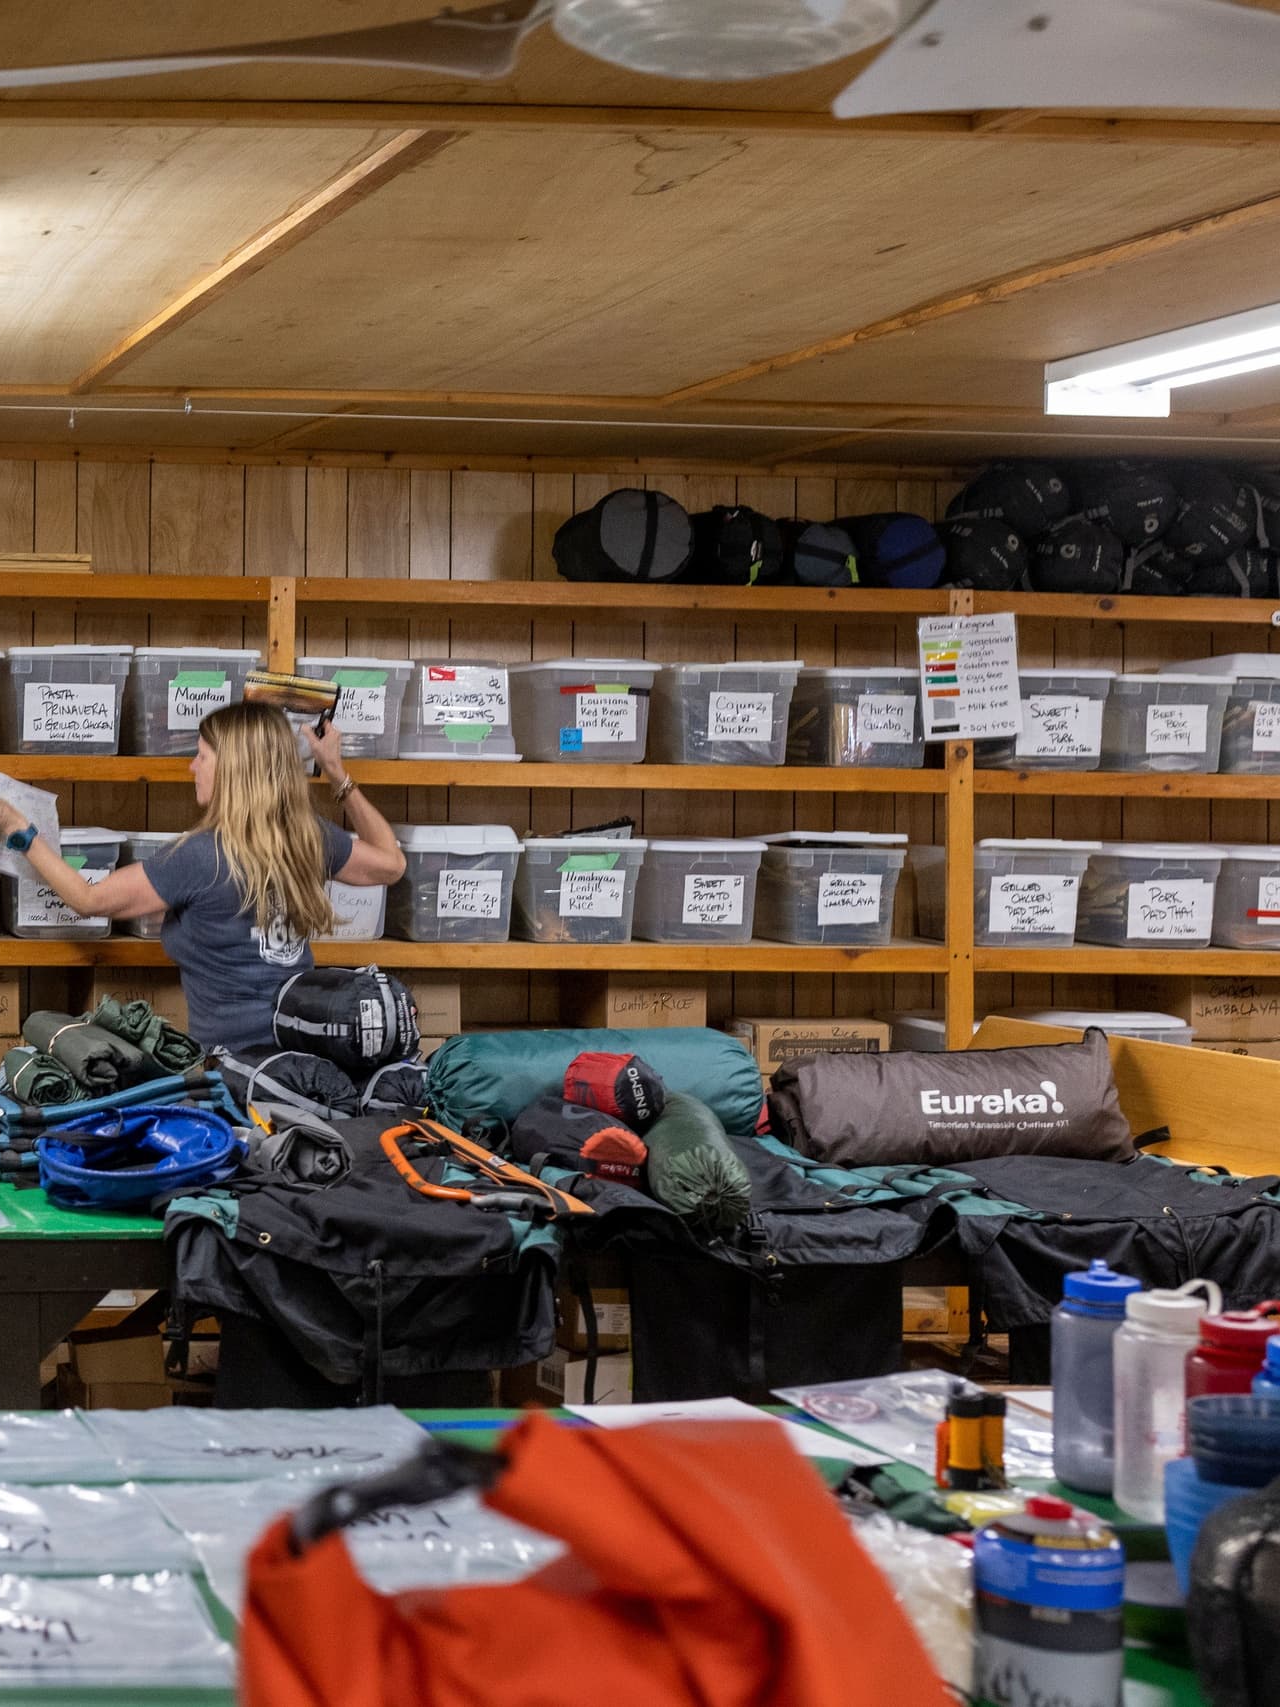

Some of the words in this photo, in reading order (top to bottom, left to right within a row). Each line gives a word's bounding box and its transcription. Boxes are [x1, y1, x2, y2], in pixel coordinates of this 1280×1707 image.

[928, 621, 954, 632] Food
[959, 619, 996, 633] Legend
[175, 688, 225, 703] Mountain
[968, 687, 987, 695] Nut
[580, 695, 629, 706] Louisiana
[715, 695, 755, 714] Cajun
[968, 702, 987, 711] Milk
[176, 703, 203, 718] Chili
[580, 707, 597, 717] Red
[602, 706, 629, 716] Beans
[860, 703, 904, 717] Chicken
[1030, 703, 1073, 718] SWEET
[600, 718, 620, 728] Rice
[715, 712, 737, 723] Rice
[714, 724, 758, 734] Chicken
[863, 718, 902, 731] Gumbo
[445, 873, 480, 891] Pepper
[565, 871, 616, 887] Himalayan
[693, 878, 726, 889] SWEET
[569, 880, 602, 893] Lentils
[448, 888, 478, 900] Beef
[576, 893, 593, 901] and
[692, 890, 730, 901] POTATO
[452, 900, 478, 913] Rice
[569, 899, 594, 911] Rice
[686, 903, 725, 913] CHICKEN
[1196, 1001, 1279, 1017] JAMBALAYA
[627, 1067, 647, 1109] NEMO
[920, 1080, 1065, 1115] Eureka!
